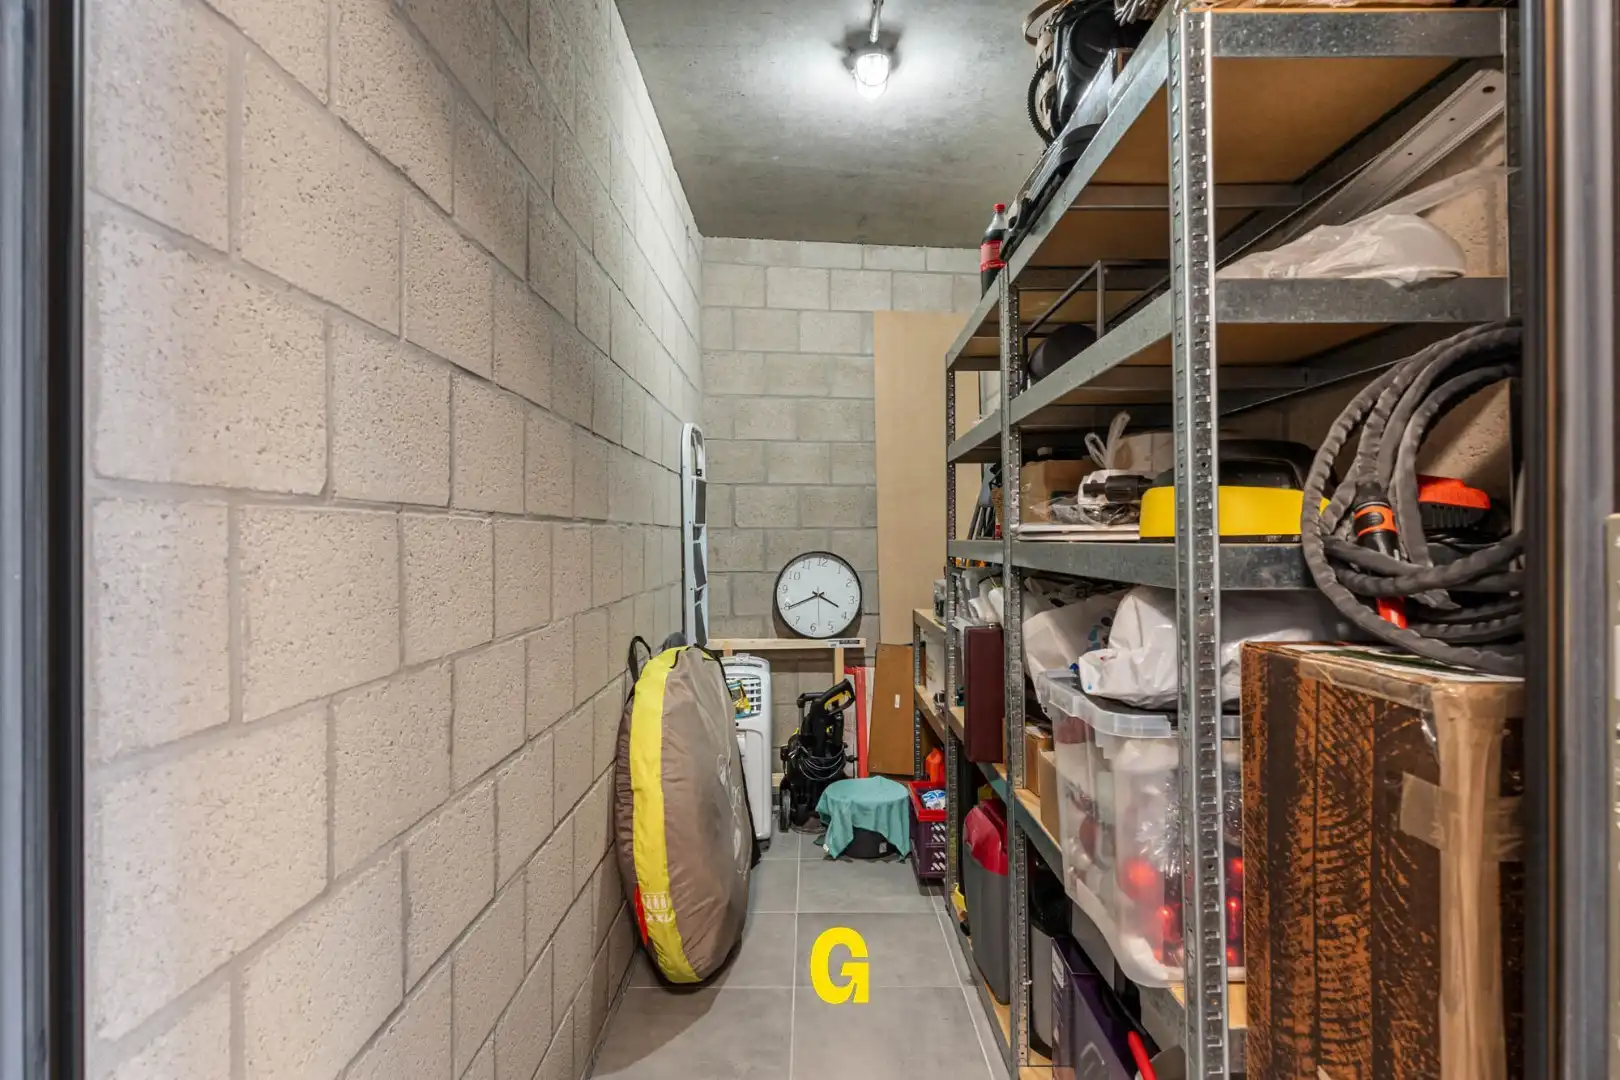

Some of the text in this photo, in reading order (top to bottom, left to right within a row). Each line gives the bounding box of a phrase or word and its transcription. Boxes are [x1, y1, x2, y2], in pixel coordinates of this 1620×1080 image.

[816, 558, 828, 567] 12
[836, 565, 841, 574] 1
[788, 570, 801, 580] 10
[845, 578, 853, 588] 2
[781, 584, 788, 594] 9
[848, 596, 855, 605] 3
[783, 601, 791, 611] 8
[841, 611, 847, 620] 4
[795, 616, 801, 625] 7
[810, 623, 817, 632] 6
[827, 620, 834, 631] 5
